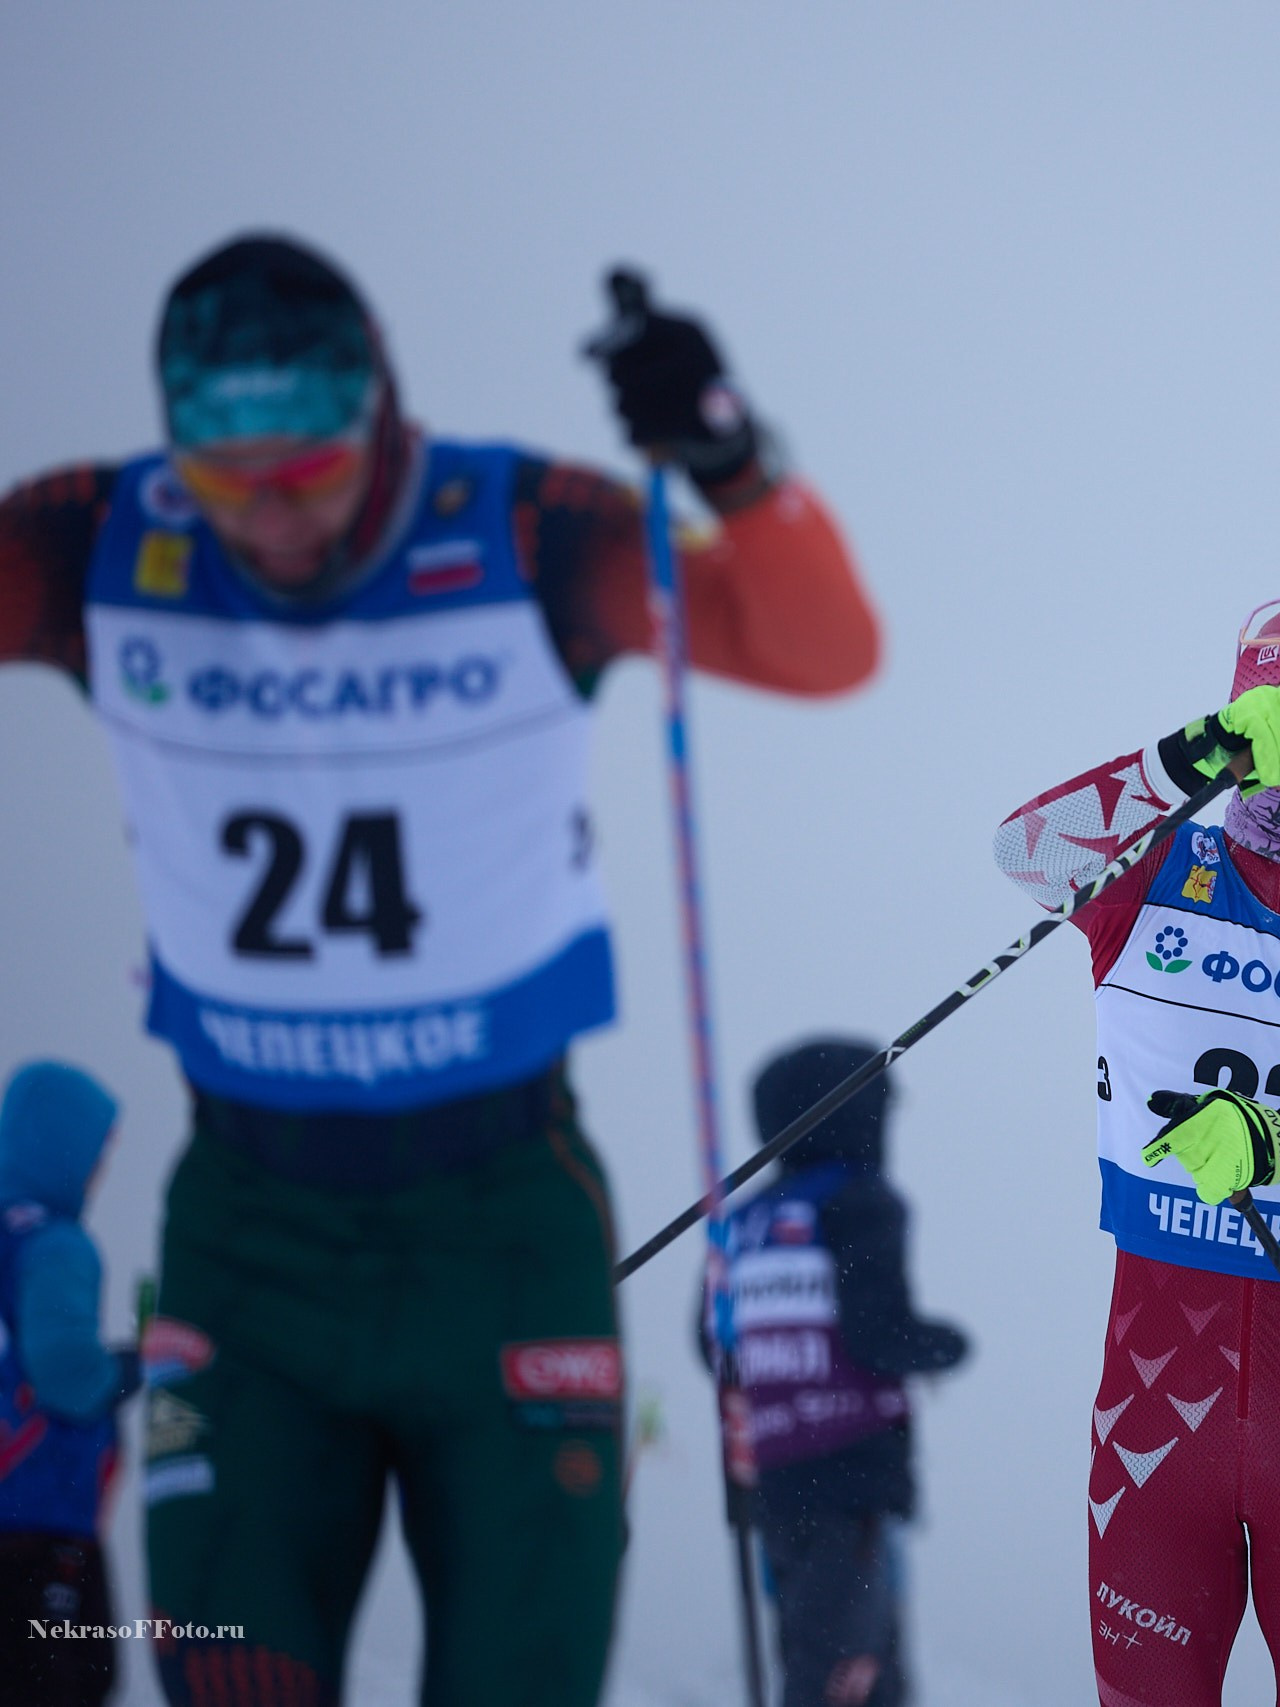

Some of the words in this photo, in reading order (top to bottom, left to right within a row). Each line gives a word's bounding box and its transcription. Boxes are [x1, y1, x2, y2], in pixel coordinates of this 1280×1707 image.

[190, 655, 500, 719] ФОСАГРО
[221, 810, 421, 958] 24
[1096, 1581, 1192, 1646] ЛУКОЙЛ
